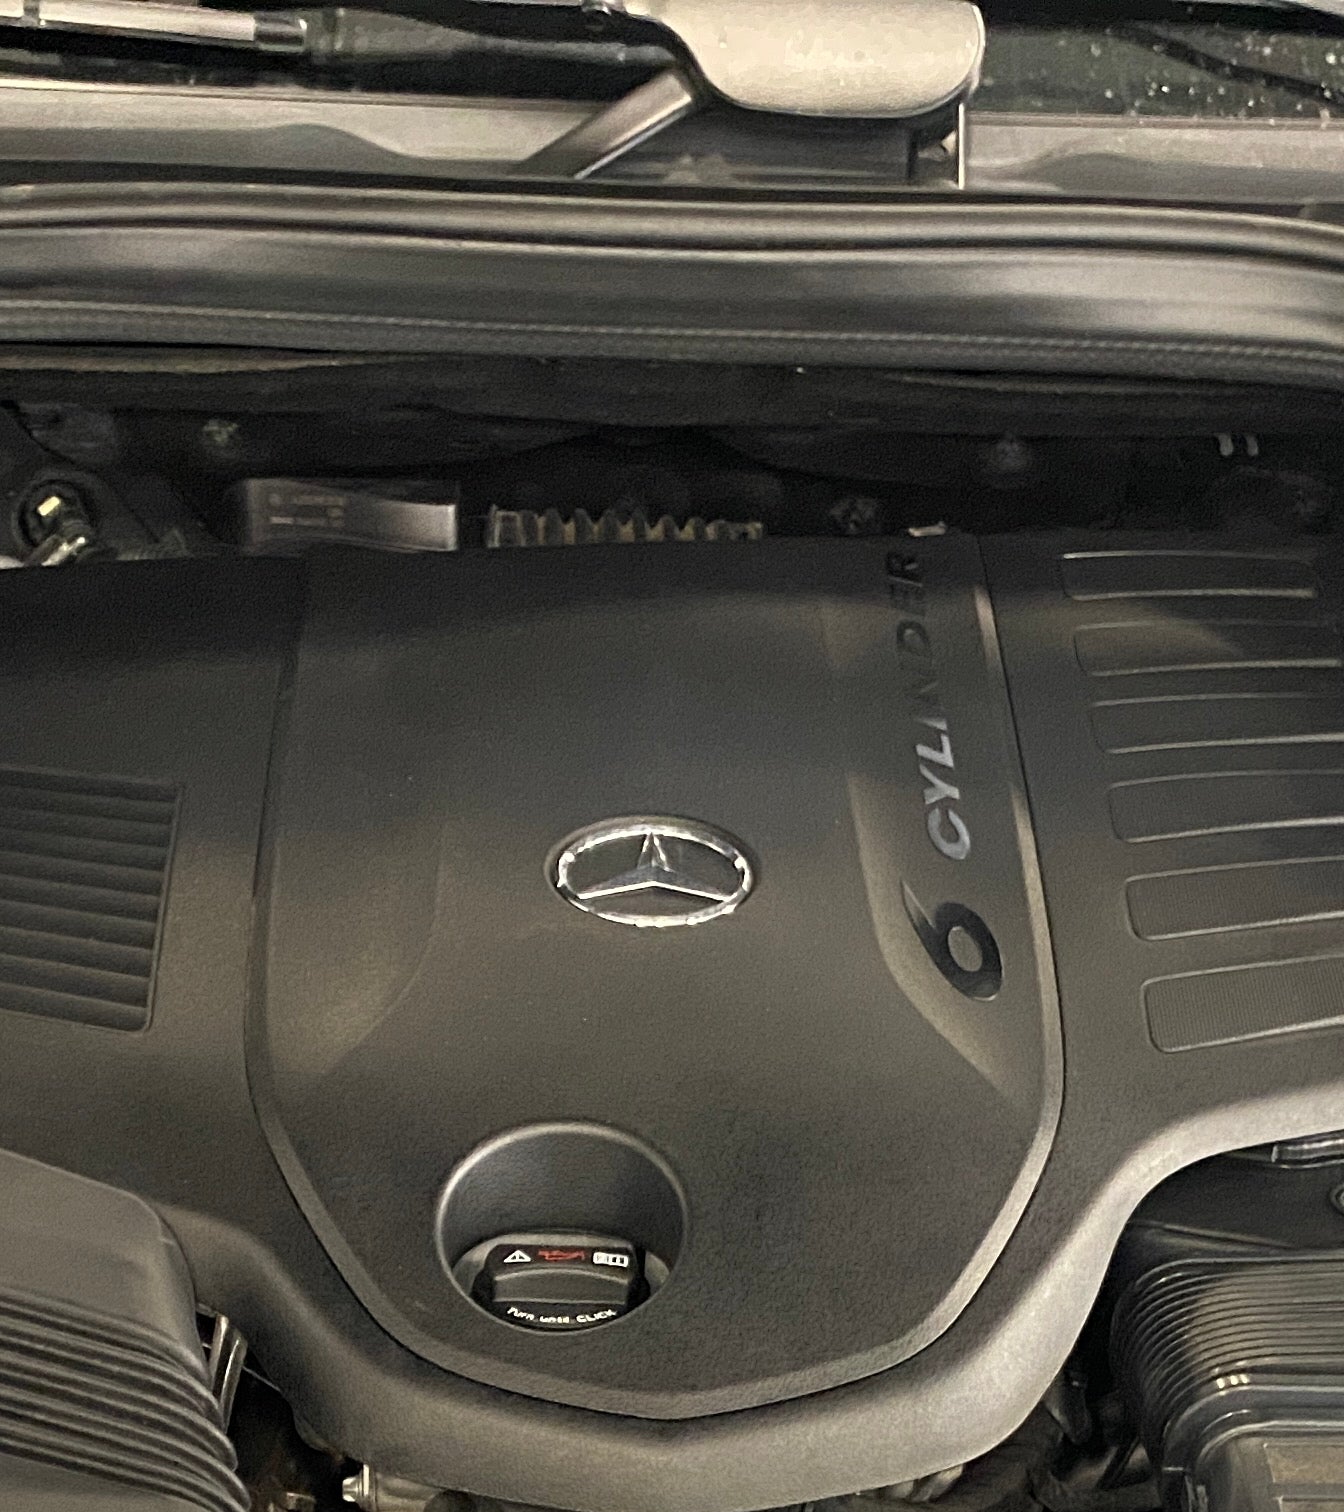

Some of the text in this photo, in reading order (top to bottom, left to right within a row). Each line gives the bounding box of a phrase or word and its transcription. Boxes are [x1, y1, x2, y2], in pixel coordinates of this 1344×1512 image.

[885, 551, 1004, 1001] 6 CYLINDER
[576, 1309, 617, 1323] CLICK
